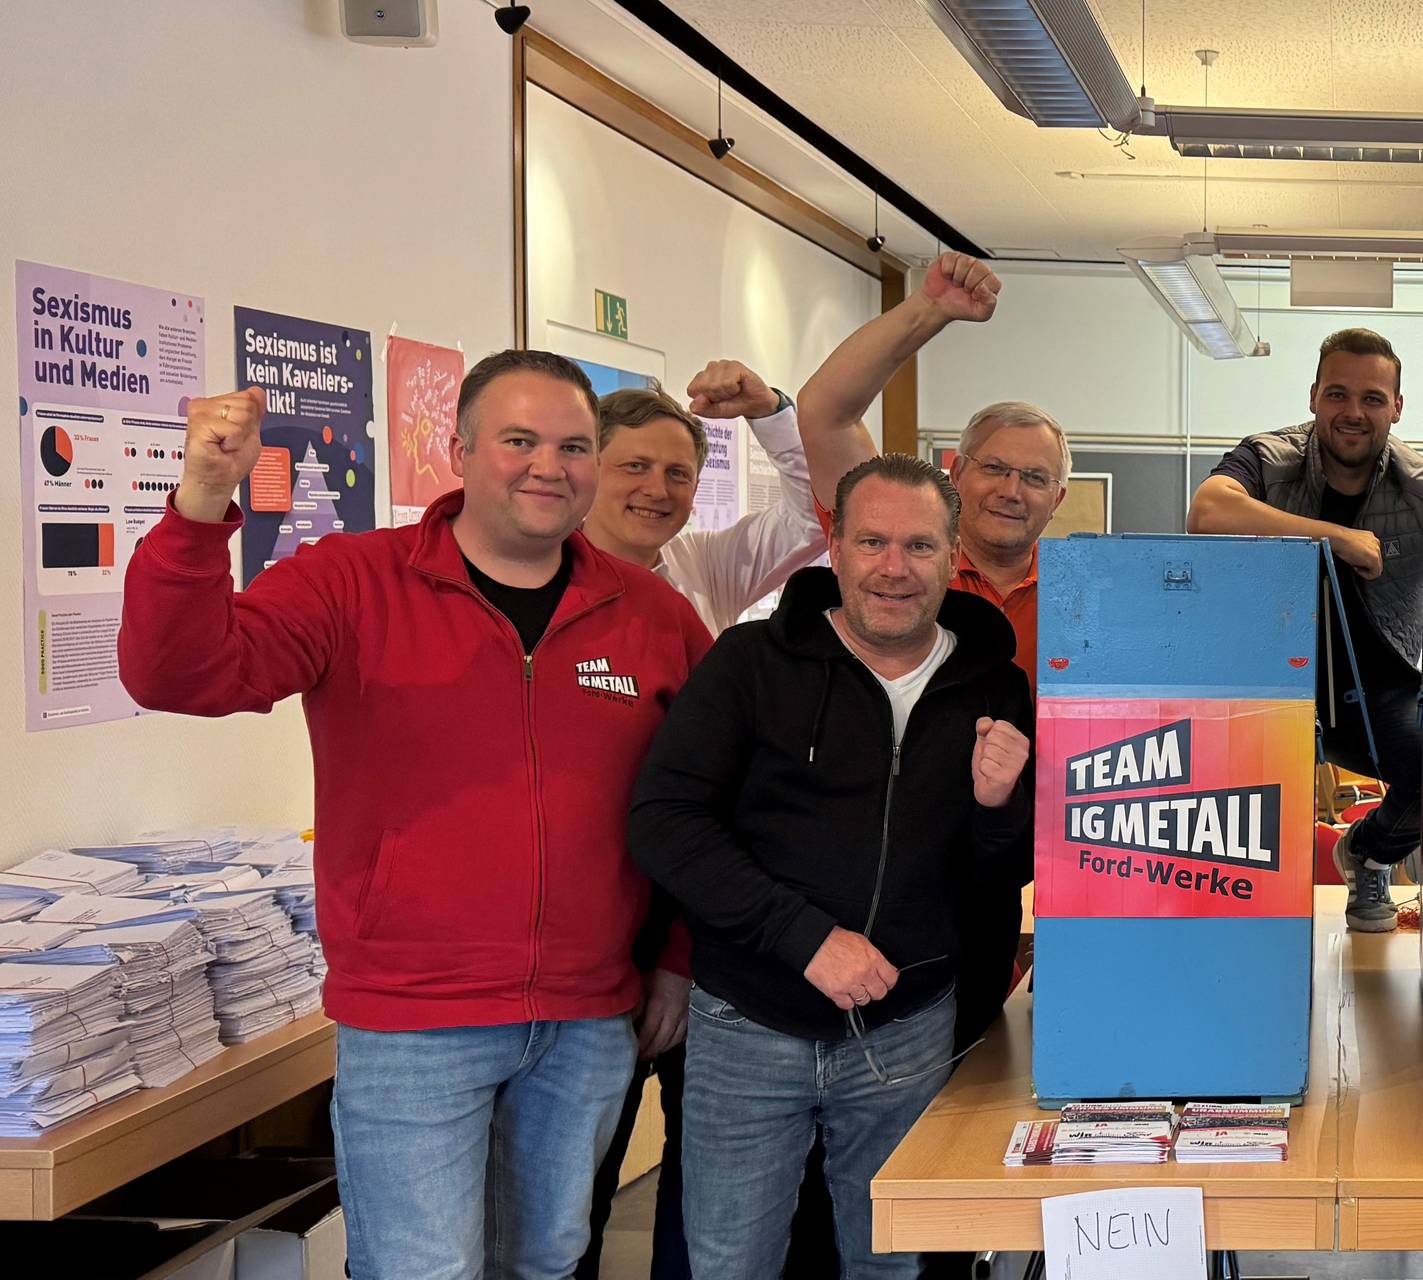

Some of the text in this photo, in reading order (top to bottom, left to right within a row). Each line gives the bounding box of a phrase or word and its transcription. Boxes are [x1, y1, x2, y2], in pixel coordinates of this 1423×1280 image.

[32, 287, 132, 330] Sexismus
[34, 320, 53, 350] in
[60, 325, 124, 360] Kultur
[245, 328, 337, 365] Sexismus ist
[34, 358, 150, 394] und Medien
[246, 357, 354, 394] kein Kavaliers-
[266, 388, 296, 415] likt!
[575, 658, 610, 673] TEAM
[578, 676, 638, 696] IG METALL
[1070, 729, 1183, 790] TEAM
[1071, 793, 1272, 862] IG METALL
[1079, 850, 1254, 900] Ford-Werke
[1074, 1208, 1170, 1256] NEIN
